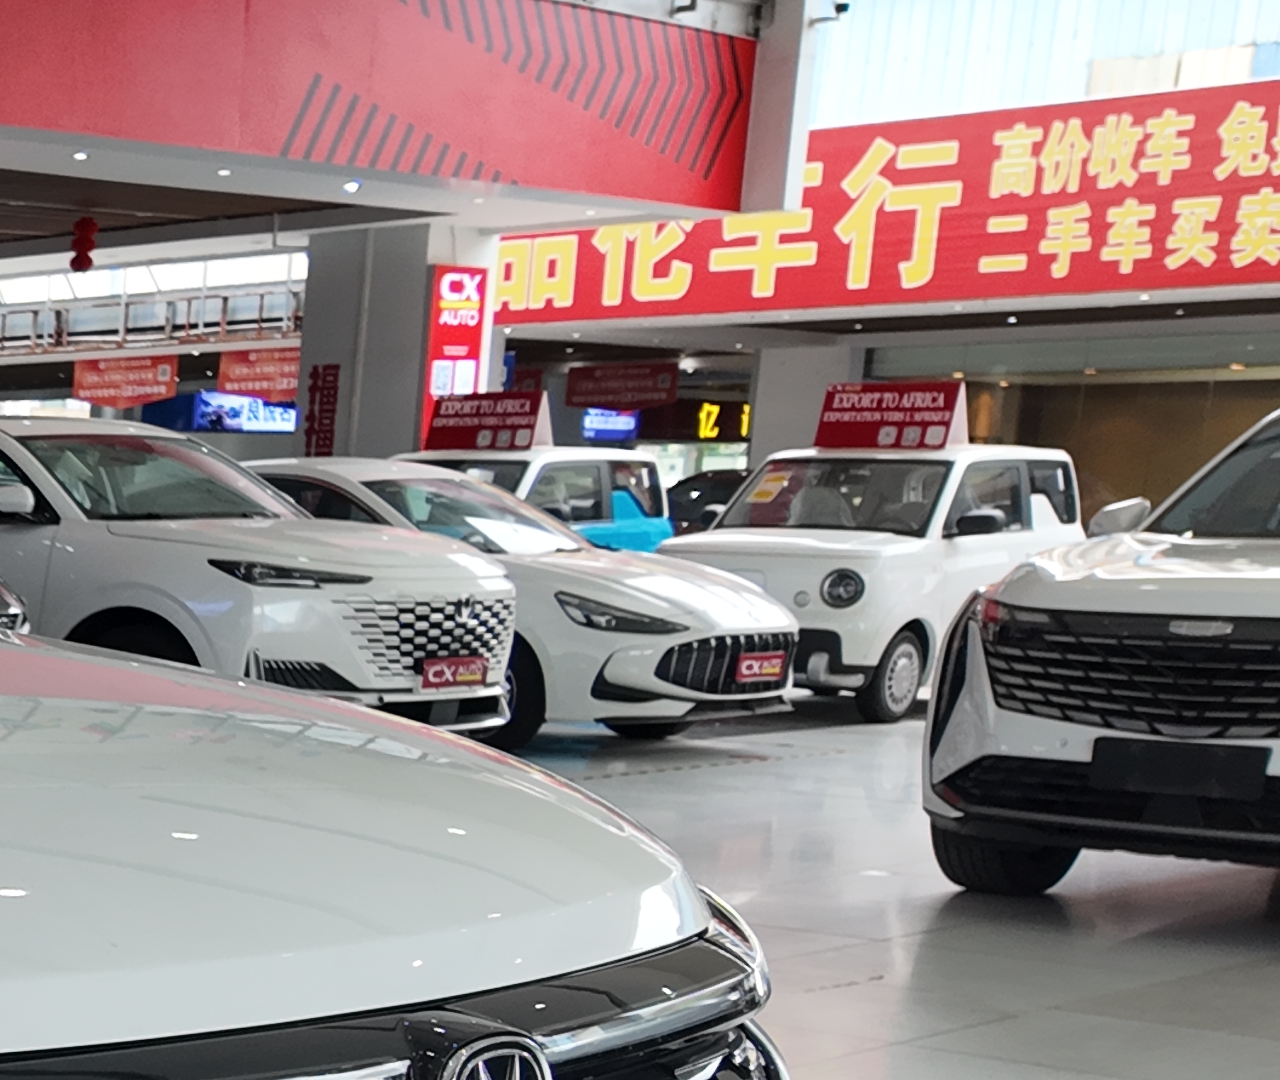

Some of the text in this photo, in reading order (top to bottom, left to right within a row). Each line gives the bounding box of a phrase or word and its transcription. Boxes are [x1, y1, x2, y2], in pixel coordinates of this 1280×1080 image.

[989, 100, 1280, 198] 高价收车 免
[441, 272, 482, 301] CX
[438, 309, 480, 327] AUTO
[439, 399, 531, 415] EXPORT TO AFRICA
[832, 391, 945, 408] EXPORT TO AFRICA
[428, 664, 456, 683] CX
[741, 660, 761, 675] CX
